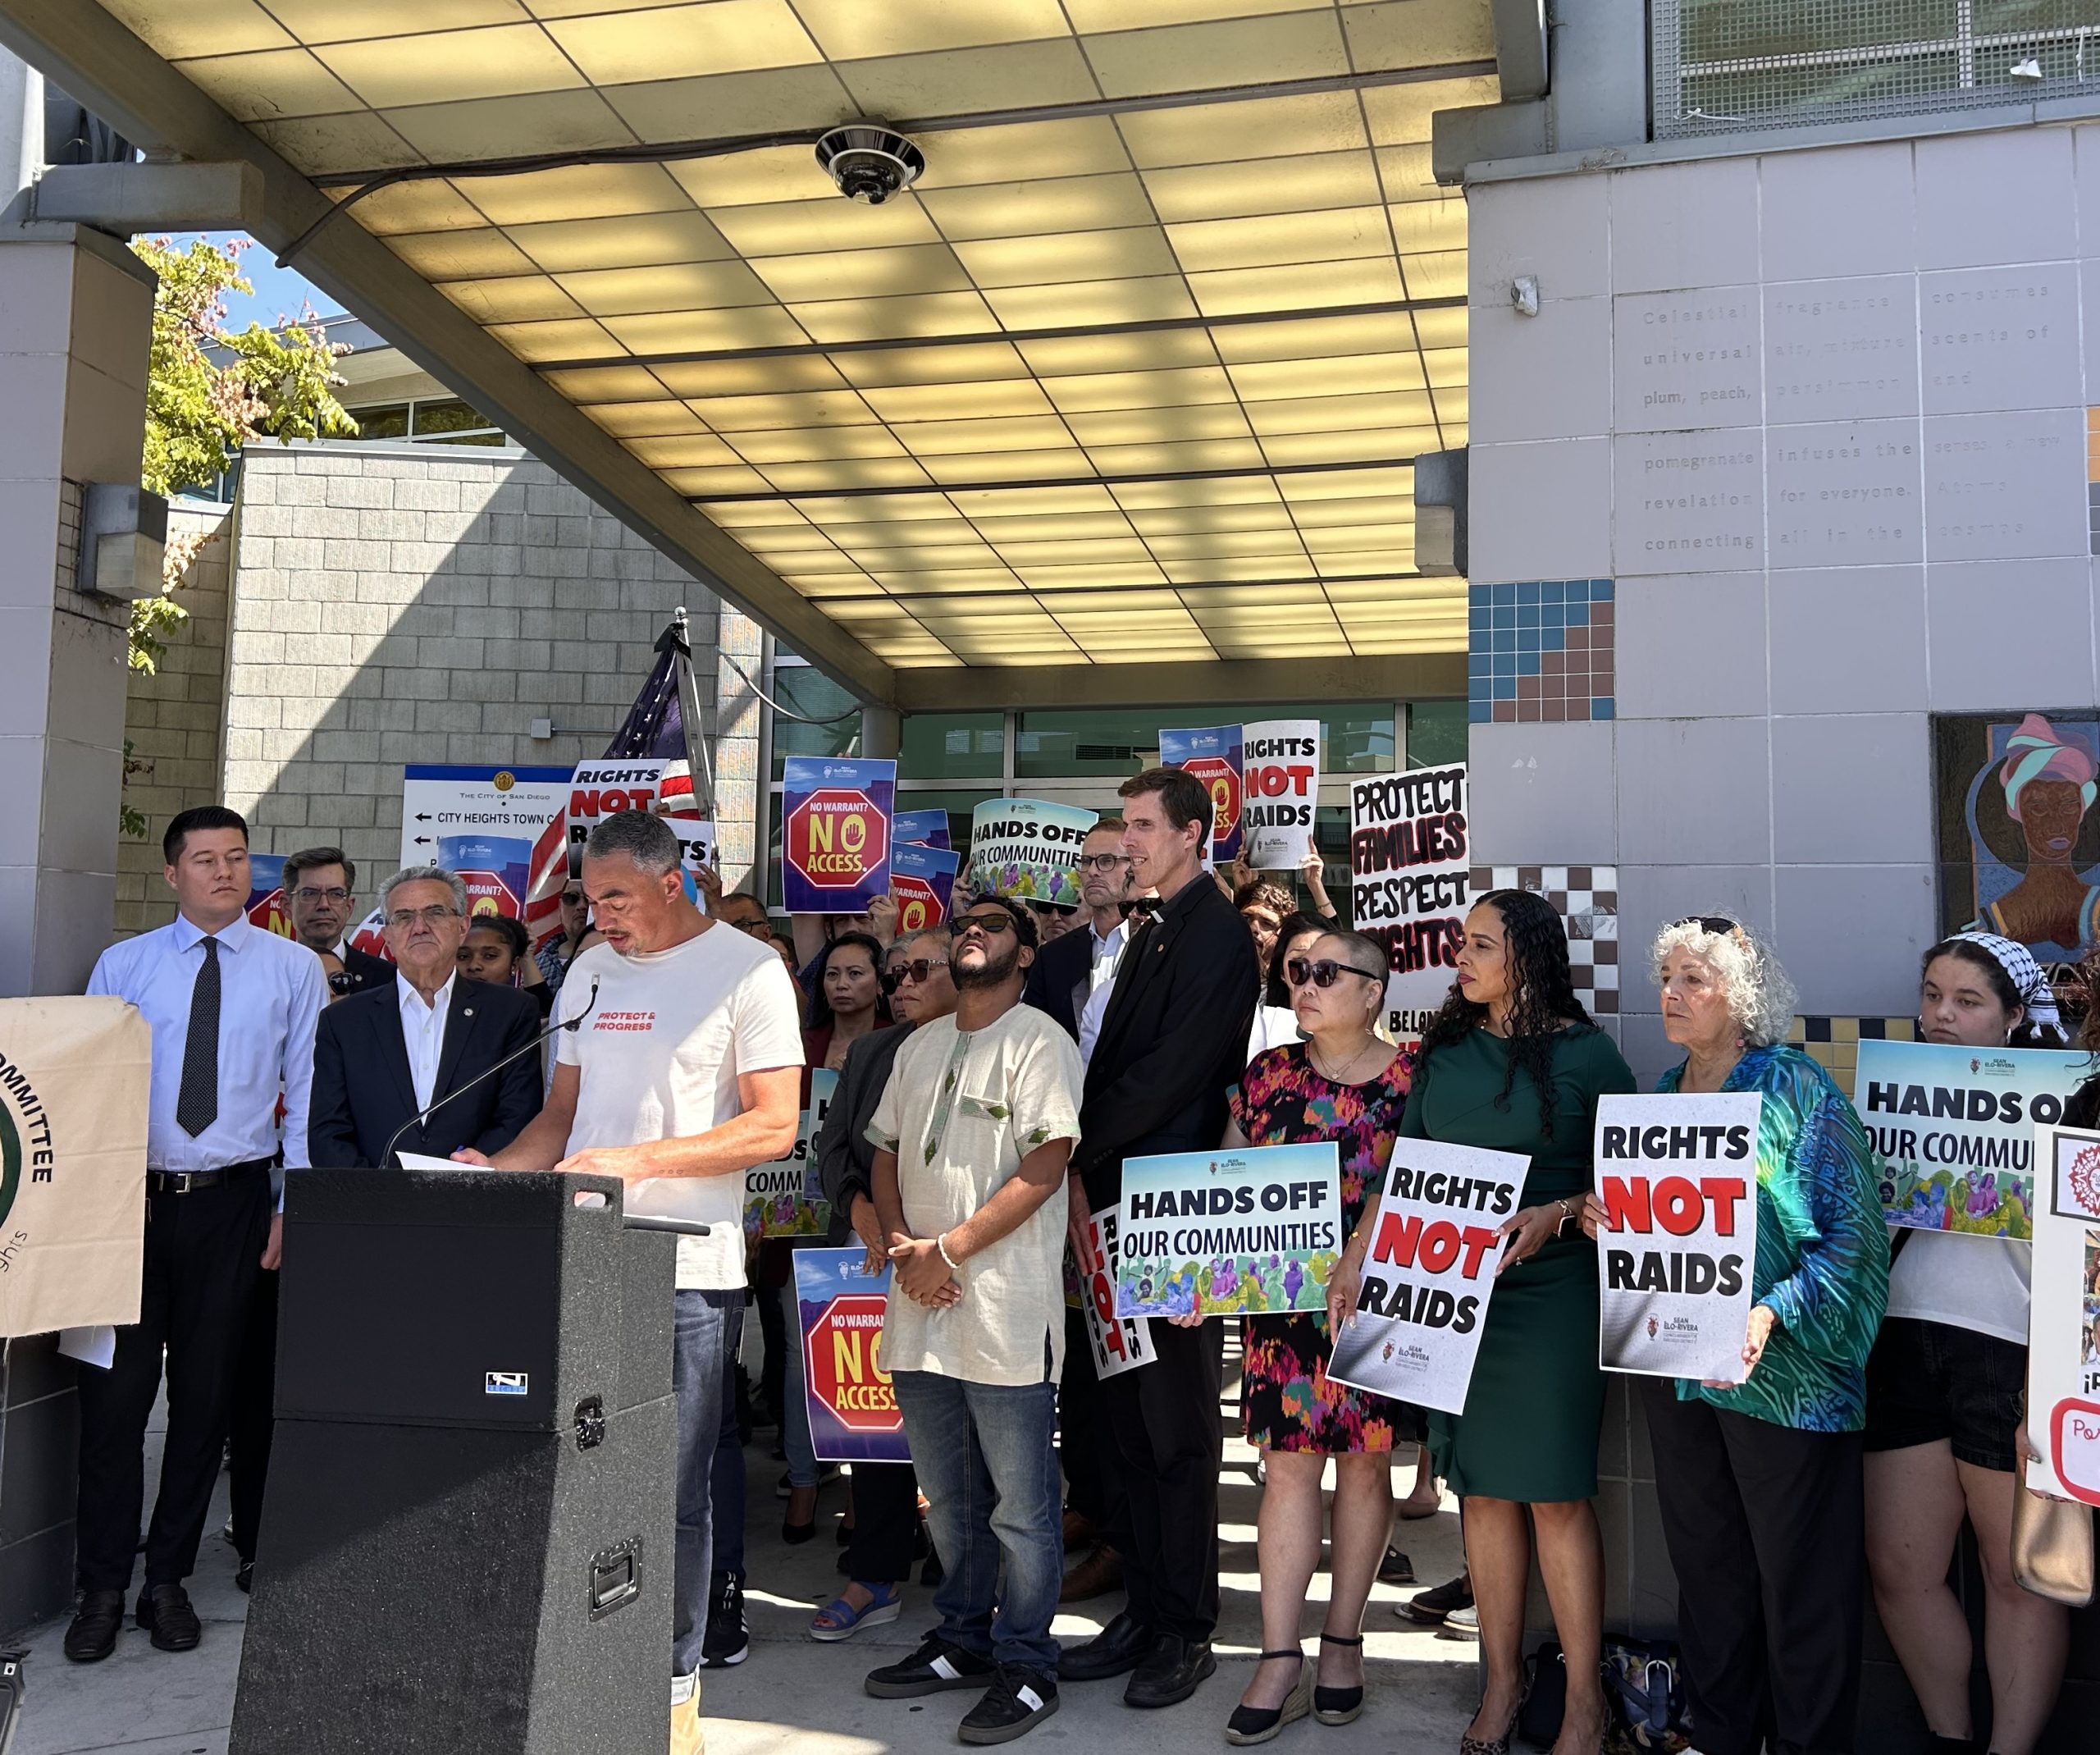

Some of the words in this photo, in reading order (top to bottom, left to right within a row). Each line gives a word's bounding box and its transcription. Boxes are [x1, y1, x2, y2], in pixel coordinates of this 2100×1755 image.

[1643, 304, 1747, 325] Celestial
[1643, 345, 1751, 366] universal
[2027, 325, 2048, 339] of
[1644, 392, 1687, 409] plum,
[1700, 386, 1752, 405] peach,
[1645, 452, 1755, 473] pomegranate
[1778, 446, 1861, 462] infuses
[1876, 442, 1912, 456] the
[1645, 493, 1753, 510] revelation
[1780, 489, 1806, 503] for
[1820, 486, 1912, 503] everyone.
[1645, 534, 1755, 551] connecting
[1867, 526, 1902, 541] the
[1244, 738, 1316, 761] RIGHTS
[576, 769, 661, 784] RIGHTS
[1245, 766, 1314, 799] NOT
[568, 788, 655, 817] NOT
[810, 802, 823, 812] NO
[823, 802, 869, 812] WARRANT?
[1354, 768, 1465, 826] PROTECT
[437, 812, 461, 824] CITY
[463, 812, 510, 825] HEIGHTS
[513, 814, 545, 825] TOWN
[1243, 804, 1312, 828] RAIDS
[974, 820, 1039, 845] HANDS
[1042, 825, 1088, 846] OFF
[1352, 811, 1467, 875] FAMILIES
[806, 853, 867, 873] ACCESS.
[1354, 871, 1469, 921] RESPECT
[592, 1022, 653, 1031] PROGRESS
[597, 1011, 647, 1021] PROTECT
[647, 1011, 656, 1020] &
[1867, 1081, 2023, 1124] HANDS
[2029, 1093, 2076, 1125] O
[1602, 1125, 1750, 1159] RIGHTS
[1922, 1131, 2034, 1172] COMMU
[746, 1169, 805, 1193] COMM
[1390, 1166, 1516, 1215] RIGHTS
[1130, 1186, 1255, 1220] HANDS
[1260, 1181, 1328, 1213] OFF
[1602, 1176, 1746, 1237] NOT
[1124, 1231, 1169, 1259] OUR
[1173, 1221, 1335, 1255] COMMUNITIES
[1372, 1211, 1501, 1280] NOT
[1607, 1250, 1744, 1296] RAIDS
[1357, 1275, 1481, 1334] RAIDS
[831, 1314, 845, 1328] NO
